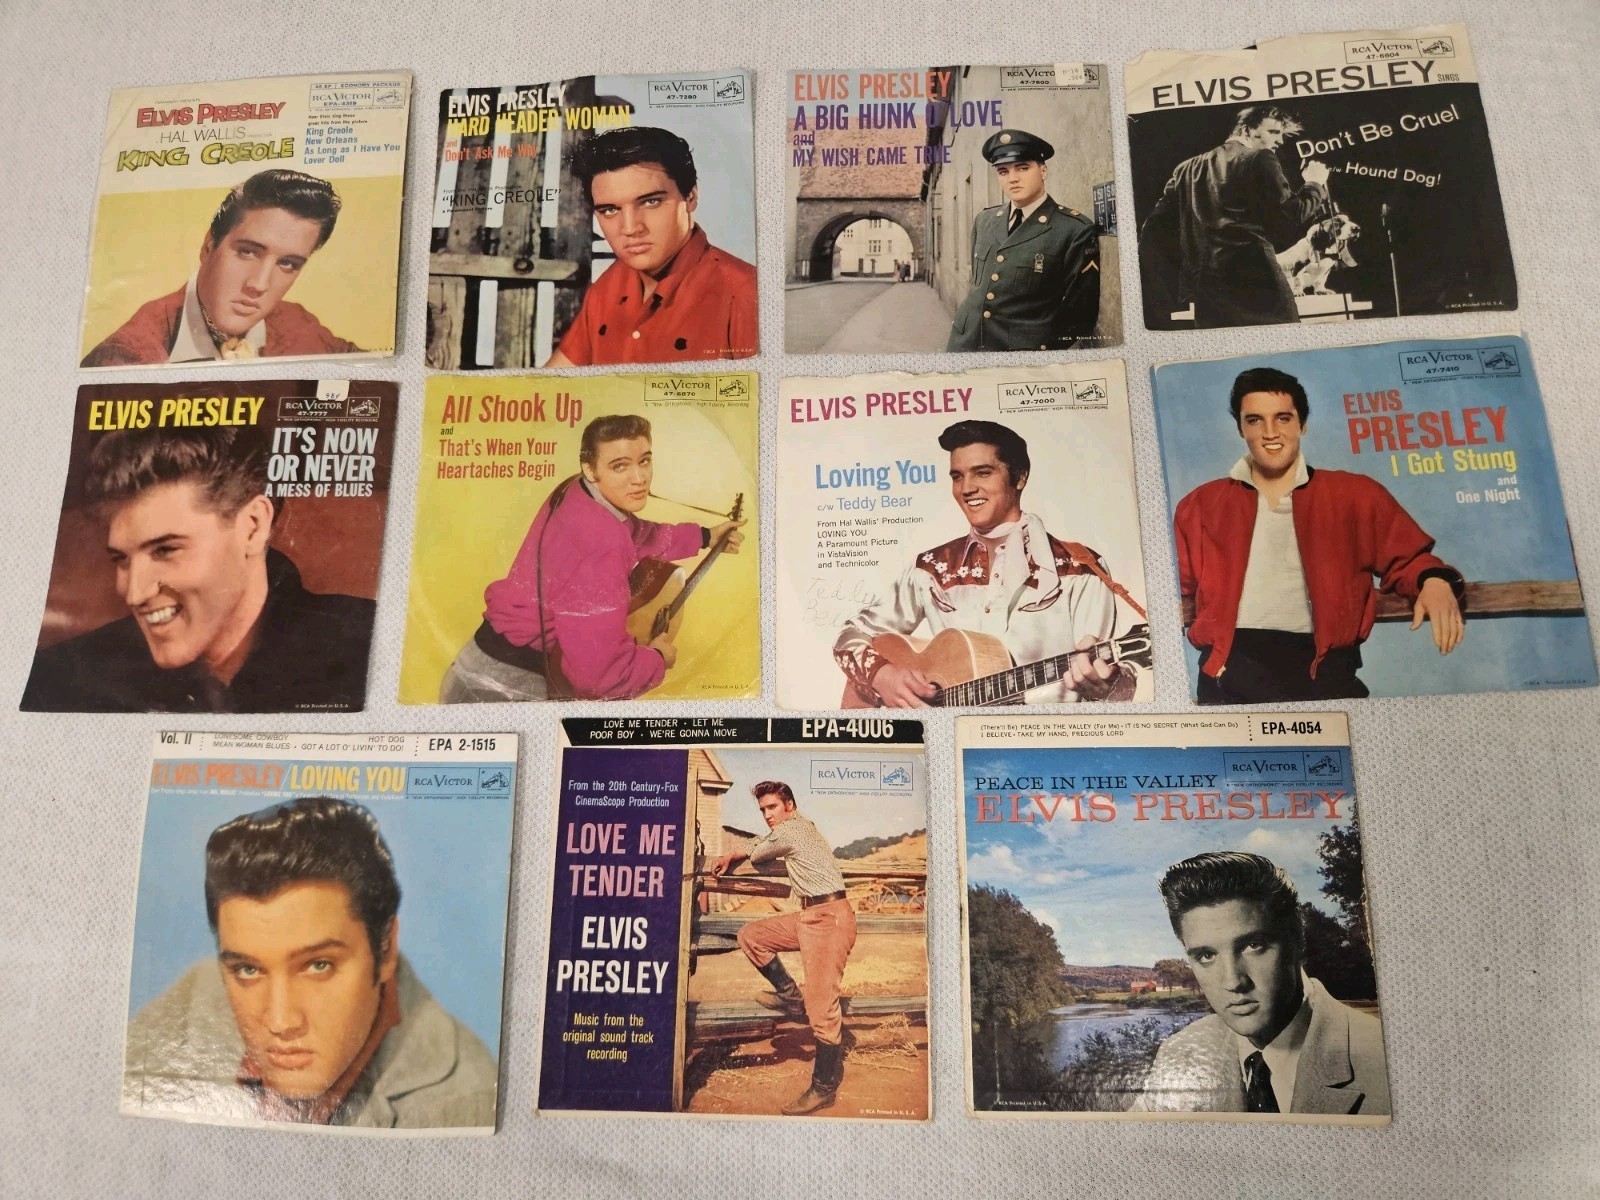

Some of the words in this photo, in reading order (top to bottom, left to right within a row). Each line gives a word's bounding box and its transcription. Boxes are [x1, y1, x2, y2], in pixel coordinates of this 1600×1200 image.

[794, 73, 849, 101] ELVIS
[859, 71, 952, 99] PRESLEY
[1152, 76, 1252, 109] ELVIS
[1266, 60, 1435, 98] PRESLEY
[1437, 73, 1460, 82] SINGS
[448, 94, 490, 118] ELVIS
[497, 85, 568, 113] PRESLEY
[137, 107, 193, 128] ELVIS
[197, 102, 286, 124] PRESLEY
[447, 115, 490, 138] HARD
[496, 110, 561, 135] HEADED
[564, 105, 631, 131] WOMAN
[793, 105, 807, 131] A
[815, 104, 849, 130] BIG
[858, 102, 916, 130] HUNK
[950, 100, 1003, 127] LOVE
[160, 130, 189, 143] HAL
[194, 127, 246, 141] WALLIS
[306, 127, 324, 136] King
[328, 126, 353, 135] Creole
[793, 130, 815, 146] and
[1295, 132, 1355, 159] Don't
[1359, 123, 1393, 142] Be
[1400, 103, 1460, 132] Cruel
[305, 137, 322, 145] New
[326, 136, 358, 144] Orleans
[117, 147, 189, 172] KING
[201, 137, 295, 164] CREOLE
[304, 147, 314, 155] As
[318, 146, 337, 156] Long
[329, 155, 345, 163] Doll
[445, 145, 470, 161] Don't
[474, 146, 493, 159] Ask
[498, 146, 513, 158] Me
[517, 143, 538, 158] Why
[793, 148, 814, 167] MY
[822, 148, 858, 166] WISH
[866, 146, 907, 165] CAME
[913, 145, 952, 164] TRUE
[1345, 162, 1397, 180] Hound
[1403, 169, 1441, 188] Dog!
[285, 402, 303, 410] RCA
[303, 399, 342, 410] VICTOR
[441, 395, 472, 424] All
[479, 393, 546, 423] Shook
[556, 392, 583, 428] Up
[790, 396, 857, 423] ELVIS
[866, 387, 973, 417] PRESLEY
[1343, 389, 1403, 415] ELVIS
[88, 399, 152, 430] ELVIS
[158, 397, 265, 428] PRESLEY
[440, 426, 454, 436] and
[1348, 406, 1507, 455] PRESLEY
[272, 427, 317, 454] IT'S
[323, 427, 379, 454] NOW
[439, 438, 482, 457] That's
[486, 438, 522, 456] When
[526, 438, 558, 456] Your
[267, 454, 300, 482] OR
[304, 454, 376, 482] NEVER
[436, 461, 513, 479] Heartaches
[518, 460, 556, 481] Begin
[1391, 454, 1399, 477] I
[1407, 451, 1445, 475] Got
[1453, 449, 1517, 473] Stung
[815, 462, 891, 491] Loving
[896, 460, 937, 485] You
[1497, 475, 1517, 485] and
[264, 483, 273, 497] A
[277, 483, 311, 498] MESS
[314, 483, 331, 498] OF
[334, 483, 374, 497] BLUES
[1455, 491, 1480, 504] One
[1485, 488, 1520, 504] Night
[837, 497, 877, 512] Teddy
[881, 495, 913, 508] Bear
[817, 520, 837, 528] From
[839, 519, 852, 527] Hal
[854, 518, 879, 526] Wallis'
[881, 516, 924, 525] Production
[817, 530, 847, 539] LOVING
[850, 529, 867, 537] YOU
[826, 540, 868, 548] Paramount
[870, 538, 898, 546] Picture
[827, 550, 868, 558] VistaVision
[835, 559, 880, 568] Technicolor
[604, 719, 625, 728] LOVE
[628, 720, 641, 728] ME
[645, 719, 678, 727] TENDER
[692, 719, 709, 727] LET
[712, 718, 724, 726] ME
[802, 718, 894, 738] EPA-4006
[1261, 721, 1322, 735] EPA-4054
[161, 732, 179, 744] Vol.
[590, 730, 613, 739] POOR
[617, 731, 635, 739] BOY
[650, 729, 676, 738] WE'RE
[679, 729, 710, 738] GONNA
[713, 728, 738, 737] MOVE
[266, 742, 290, 750] BLUES
[429, 738, 452, 751] EPA
[459, 738, 496, 751] 2-1515
[366, 766, 406, 792] YOU
[818, 770, 836, 778] RCA
[836, 767, 876, 780] VICTOR
[974, 776, 1044, 790] PEACE
[1051, 776, 1076, 790] IN
[1082, 775, 1127, 789] THE
[1132, 774, 1218, 788] VALLEY
[568, 780, 589, 791] From
[592, 780, 605, 791] the
[608, 780, 627, 791] 20th
[630, 781, 679, 794] Century-Fox
[575, 795, 626, 808] CinemaScope
[628, 796, 670, 808] Production
[974, 793, 1117, 824] ELVIS
[1132, 790, 1349, 821] PRESLEY
[566, 822, 627, 854] LOVE
[639, 824, 676, 855] ME
[569, 864, 664, 898] TENDER
[581, 916, 649, 950] ELVIS
[556, 960, 669, 994] PRESLEY
[573, 1013, 599, 1026] Music
[604, 1013, 625, 1026] from
[629, 1014, 644, 1026] the
[562, 1030, 595, 1044] original
[600, 1031, 627, 1043] sound
[631, 1031, 654, 1043] track
[587, 1048, 628, 1063] recording
